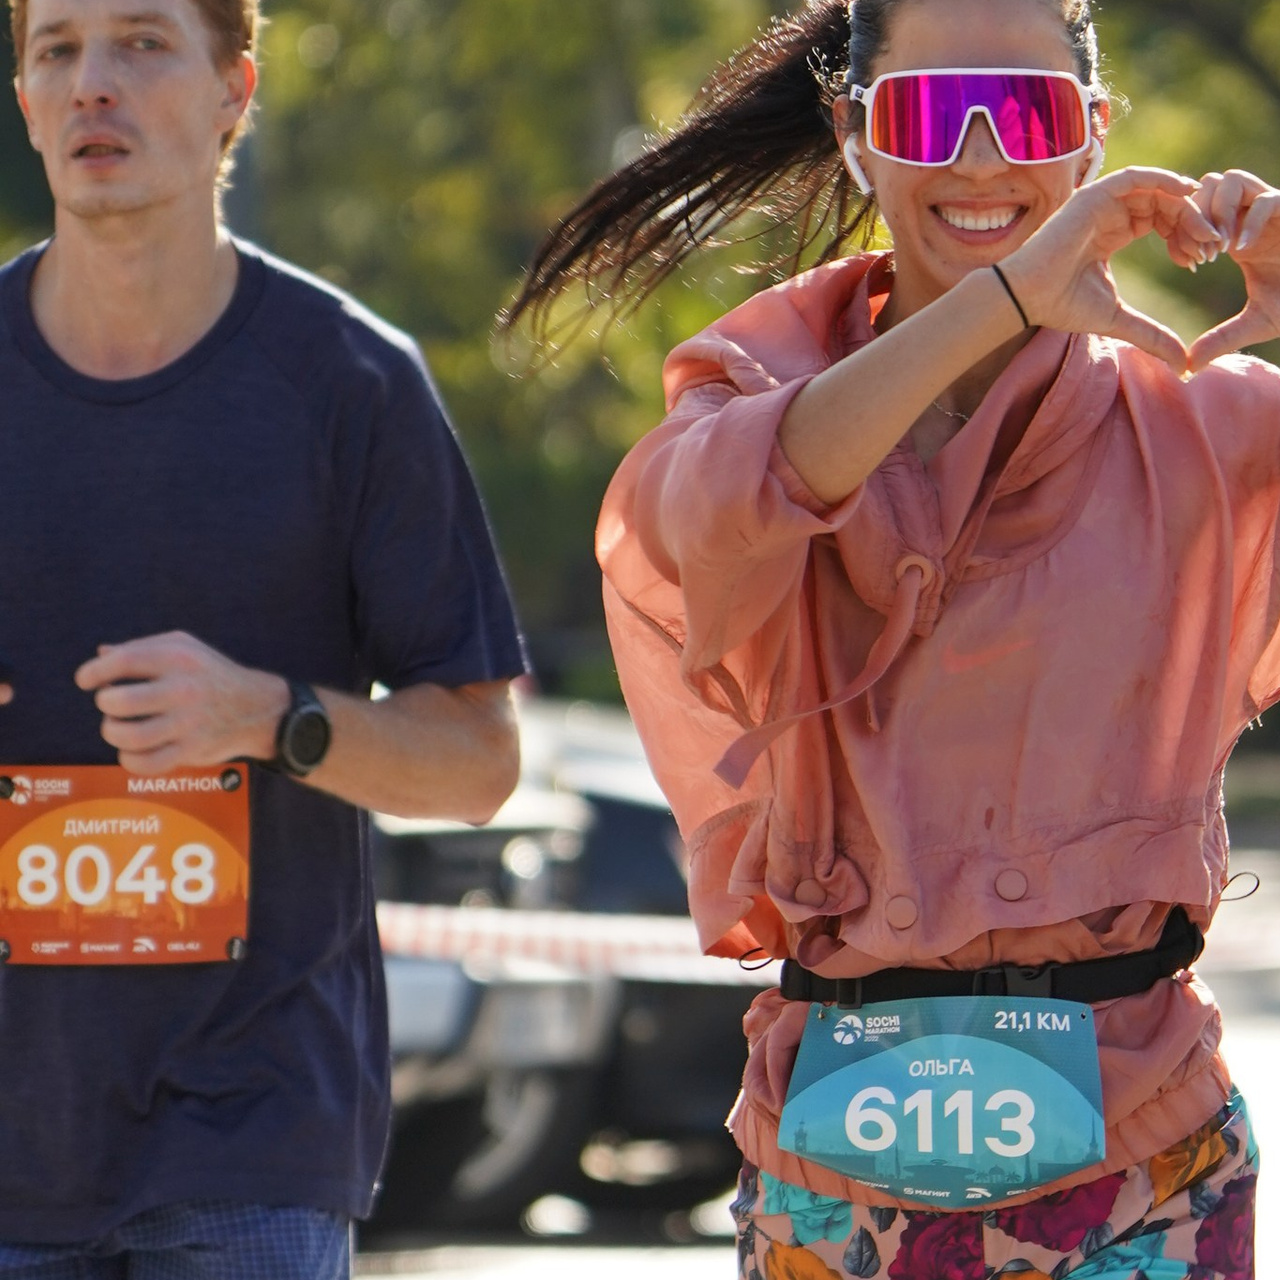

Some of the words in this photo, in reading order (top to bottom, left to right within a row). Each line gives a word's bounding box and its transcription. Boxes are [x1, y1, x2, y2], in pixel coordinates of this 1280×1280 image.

[63, 816, 160, 837] ДМИТРИЙ
[17, 844, 215, 907] 8048
[865, 1026, 900, 1035] MARATHON
[866, 1016, 900, 1028] SOCHI
[994, 1011, 1031, 1032] 21,1
[1037, 1012, 1071, 1031] KM
[909, 1058, 974, 1077] ОЛЬГА
[845, 1086, 1036, 1157] 6113
